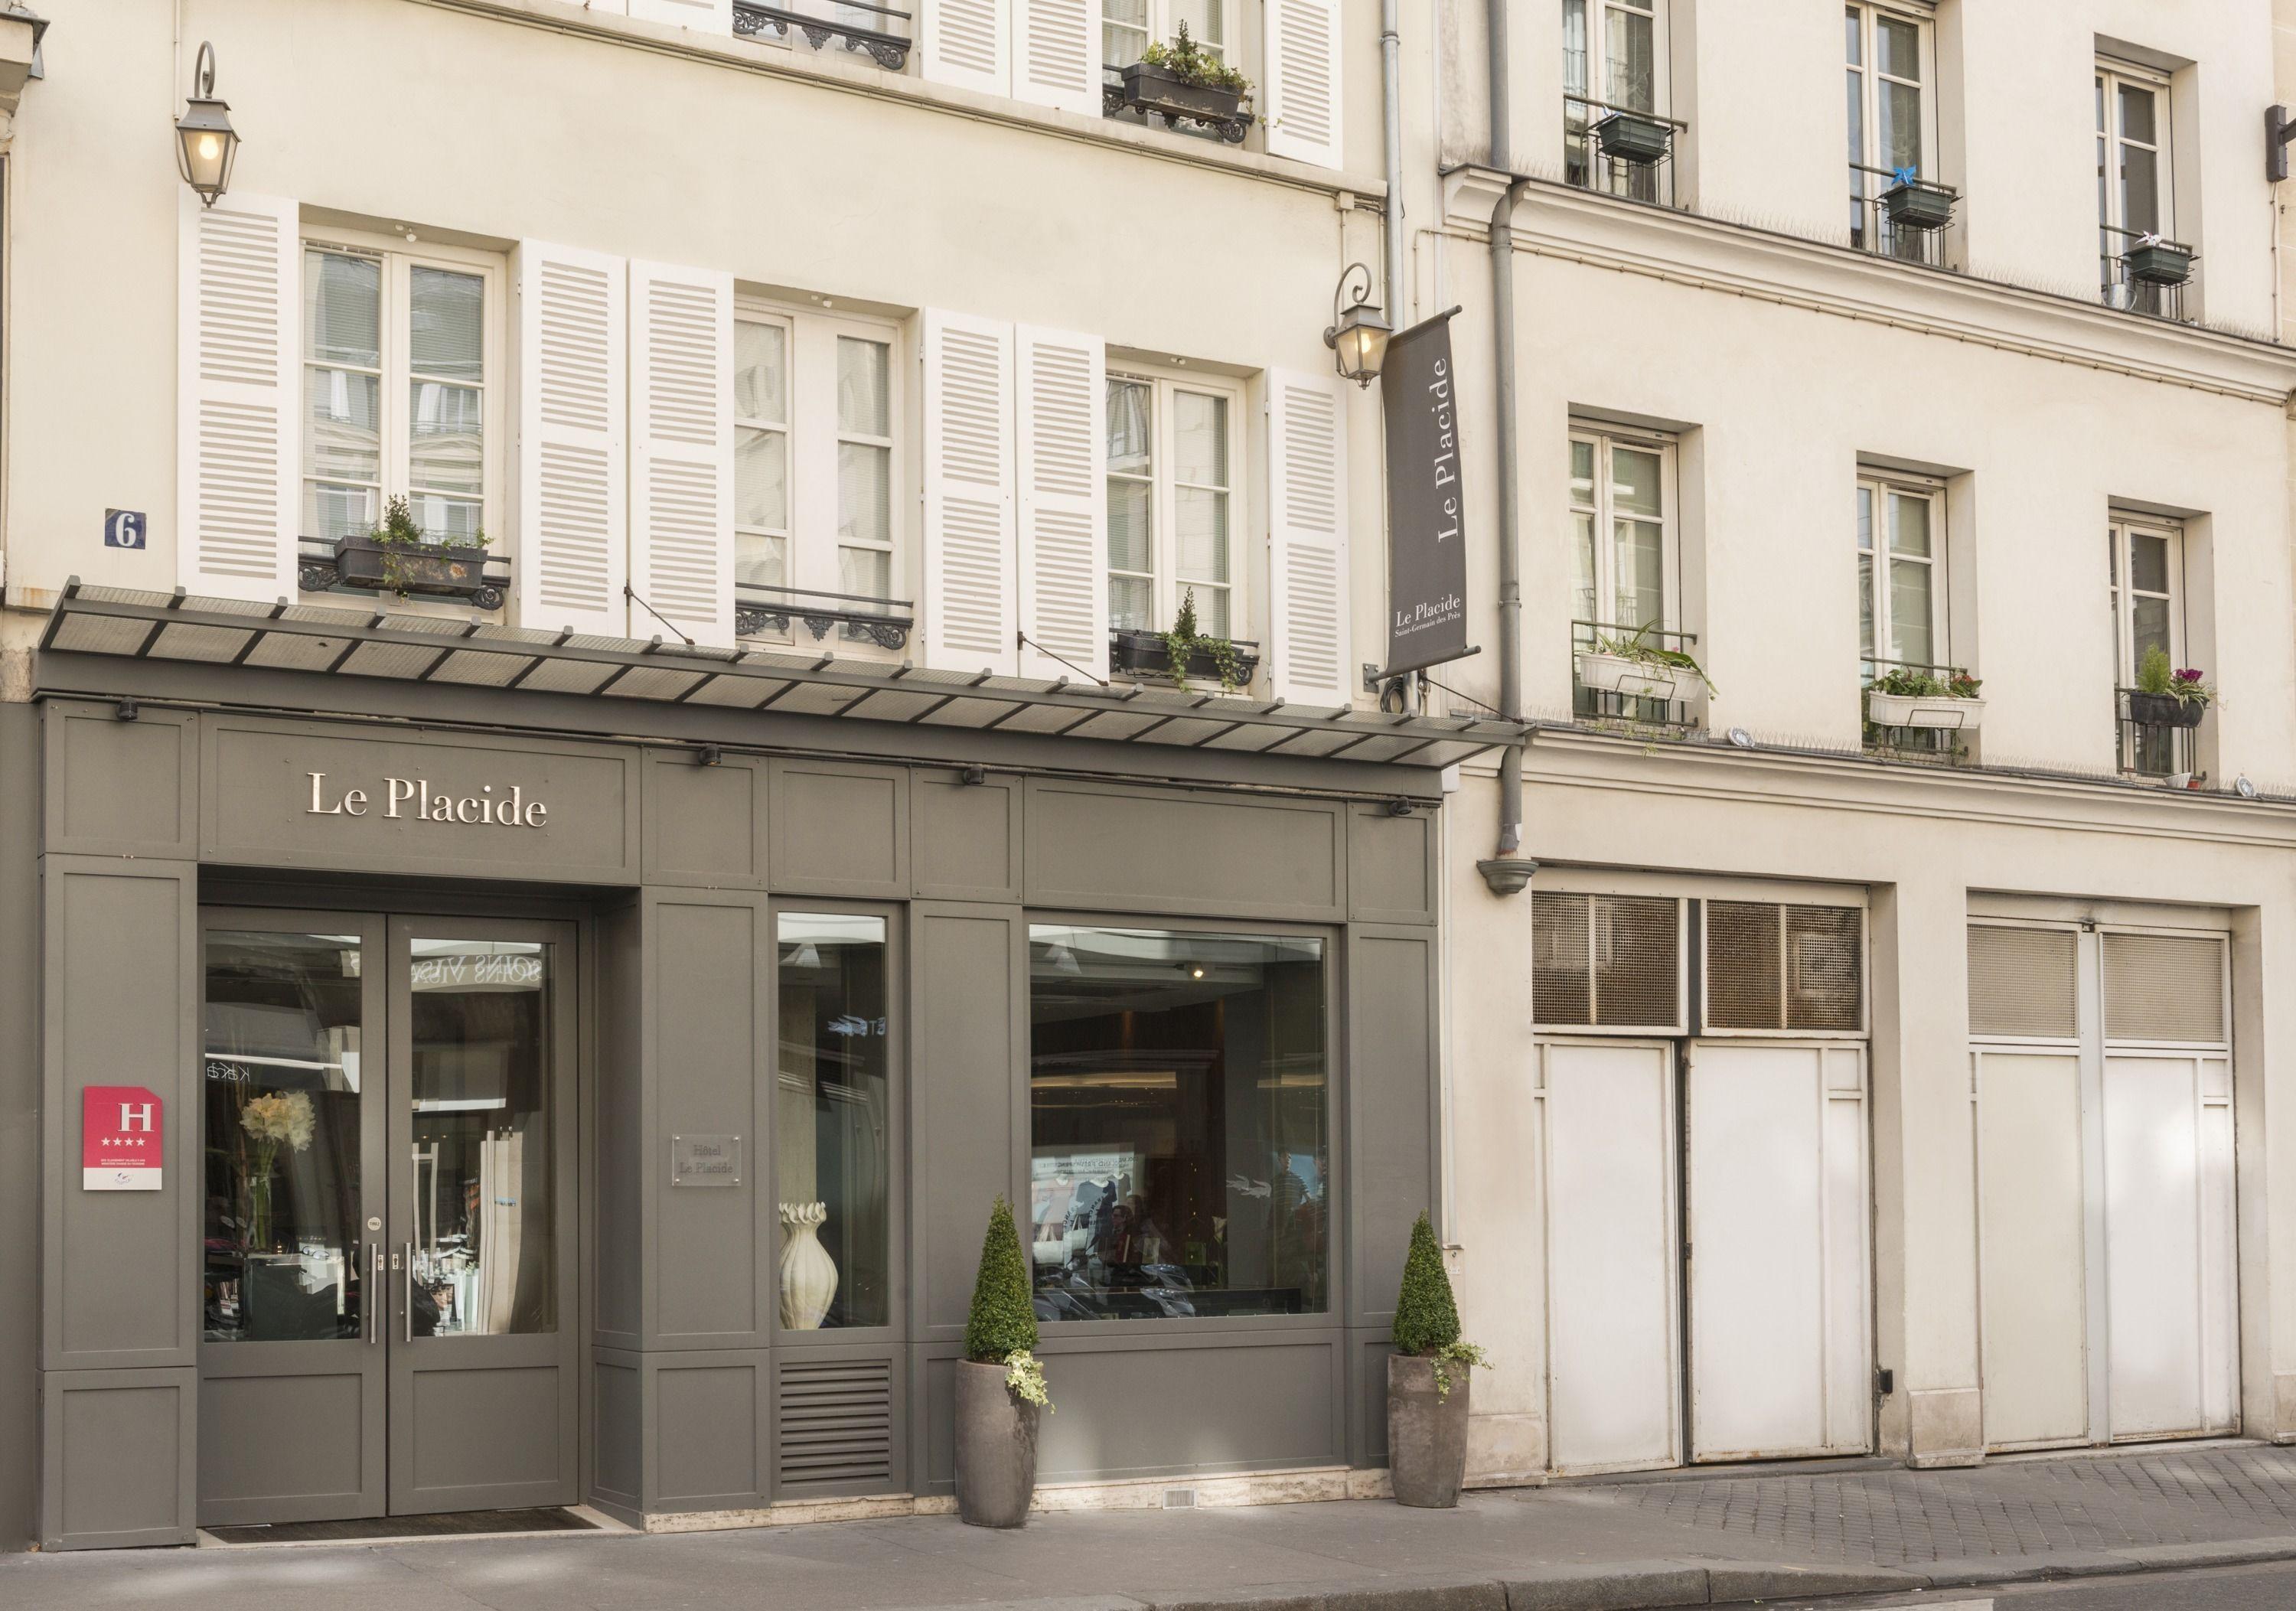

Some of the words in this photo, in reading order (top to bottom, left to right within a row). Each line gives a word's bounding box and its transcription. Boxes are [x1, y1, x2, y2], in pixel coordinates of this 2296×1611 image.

[1429, 357, 1456, 489] Placide
[116, 513, 135, 547] 6
[1437, 496, 1458, 543] Le
[1394, 618, 1435, 637] Saint-Germain
[1436, 615, 1446, 624] des
[1447, 611, 1461, 621] Près
[1396, 611, 1411, 627] Le
[1415, 594, 1460, 621] Placide
[306, 772, 367, 816] Le
[383, 777, 547, 827] Placide
[117, 1103, 155, 1132] H
[693, 1144, 721, 1156] Hôtel
[680, 1162, 693, 1173] Le
[696, 1161, 734, 1173] Placide
